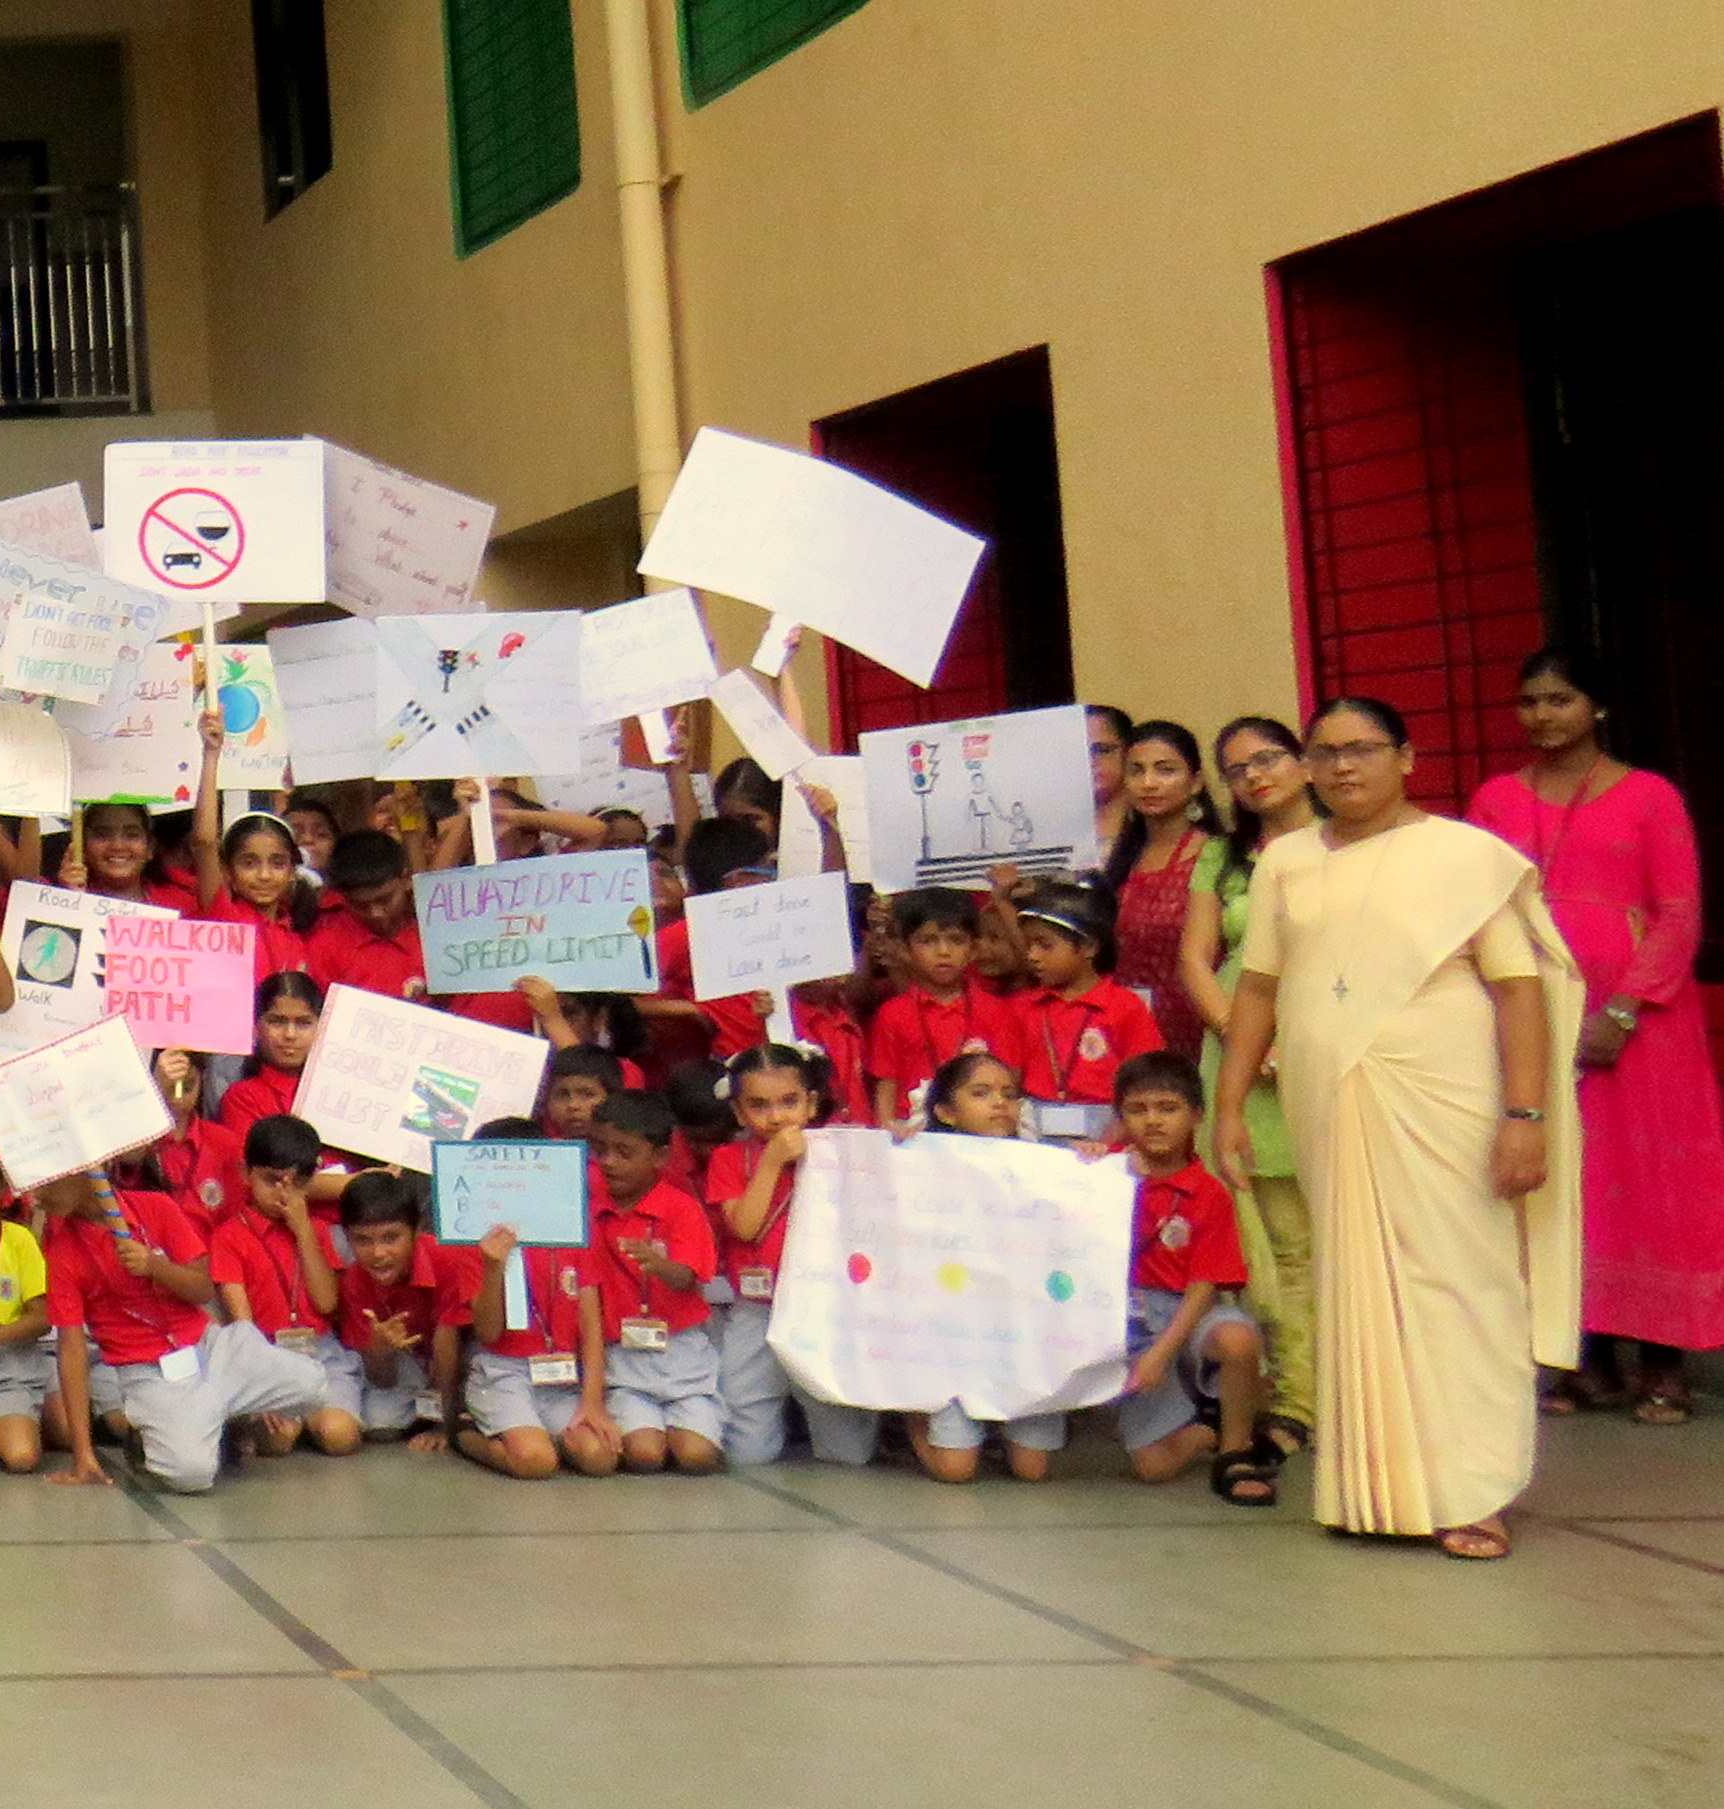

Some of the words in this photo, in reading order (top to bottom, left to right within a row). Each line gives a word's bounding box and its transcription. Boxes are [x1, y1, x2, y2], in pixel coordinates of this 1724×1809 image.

[495, 913, 549, 938] IN
[440, 937, 531, 977] SPEED
[545, 931, 637, 966] LIMIT
[106, 952, 194, 987] FOOT
[106, 989, 193, 1025] PATH
[452, 1173, 472, 1196] A
[455, 1195, 471, 1215] B
